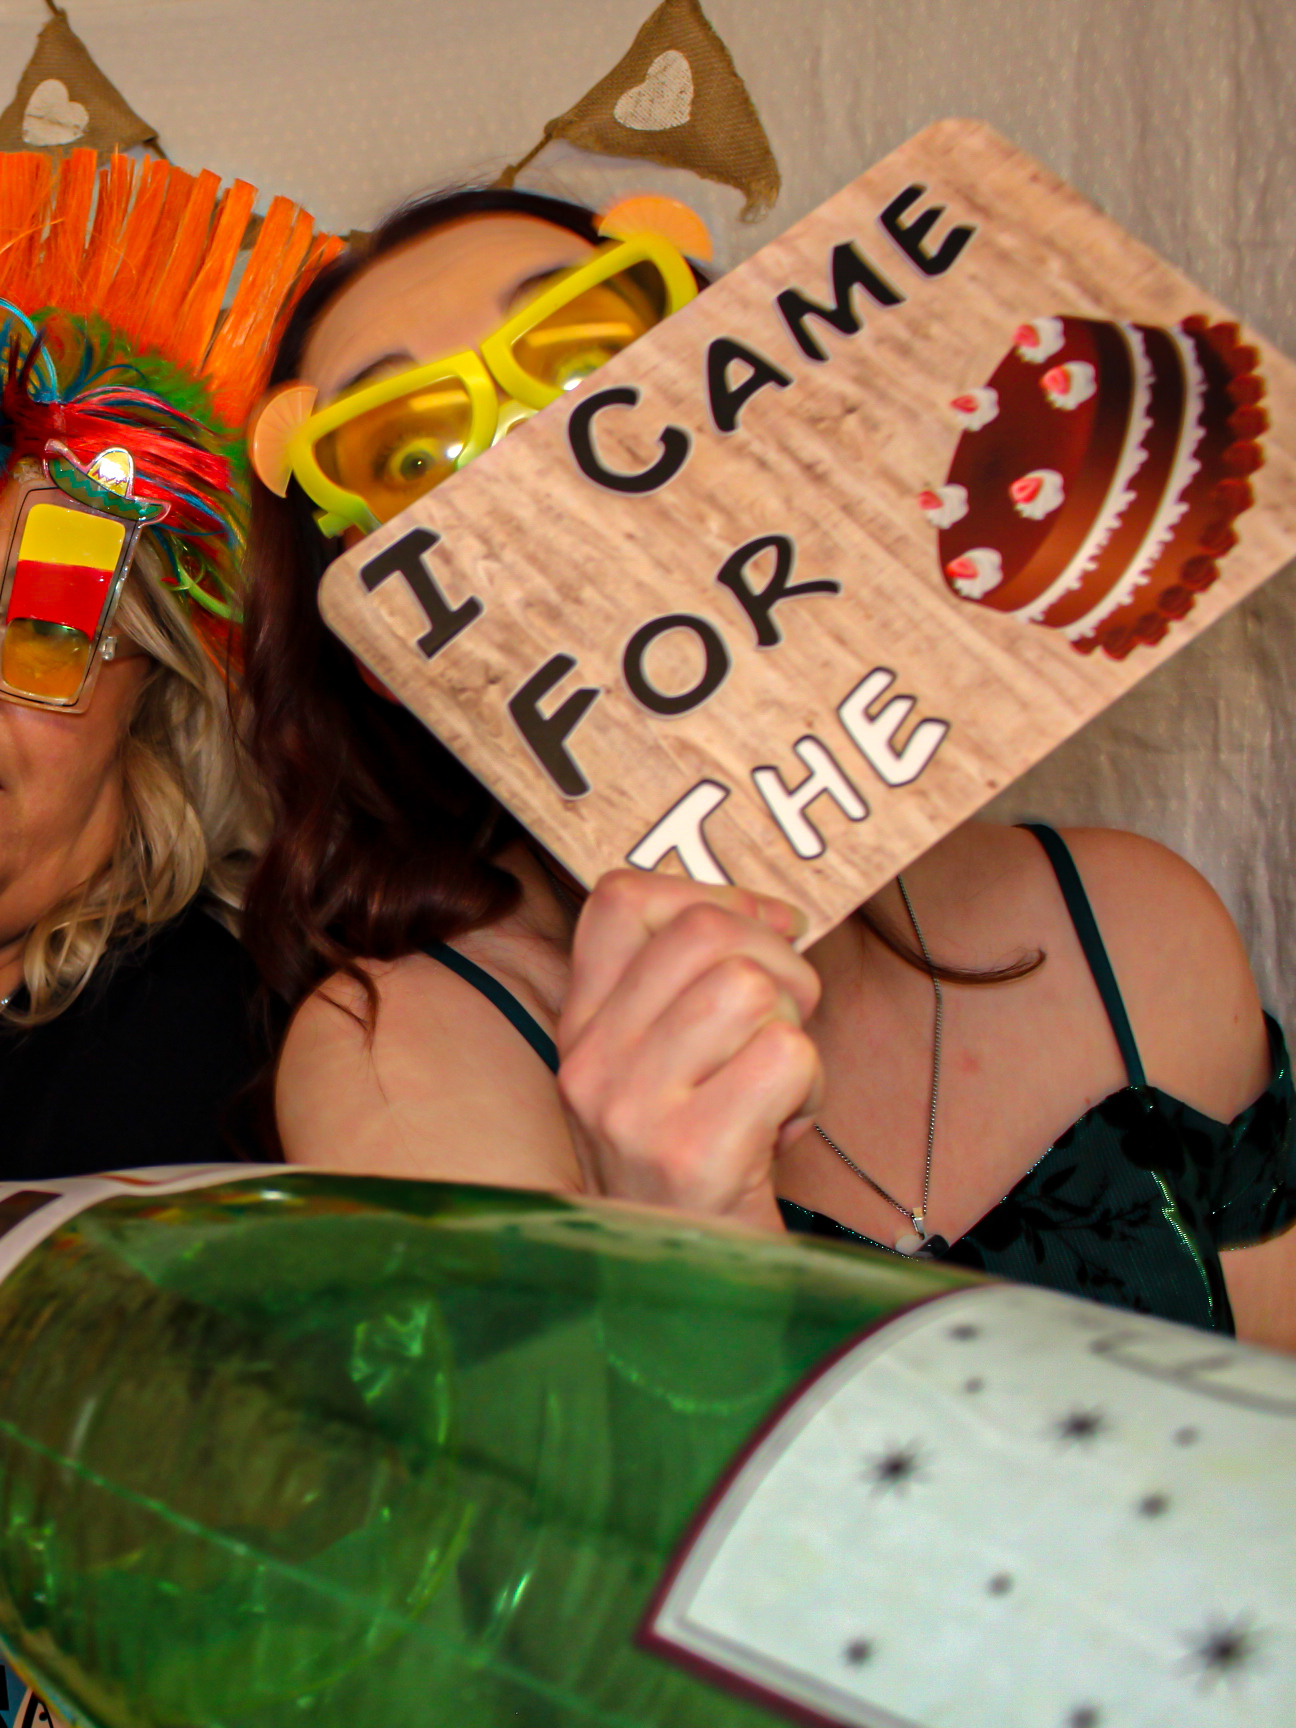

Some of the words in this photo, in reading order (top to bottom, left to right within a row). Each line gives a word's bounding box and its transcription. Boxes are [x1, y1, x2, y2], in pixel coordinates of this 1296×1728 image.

[360, 527, 484, 659] I
[567, 183, 979, 496] CAME
[508, 534, 842, 798] FOR
[625, 666, 951, 886] THE
